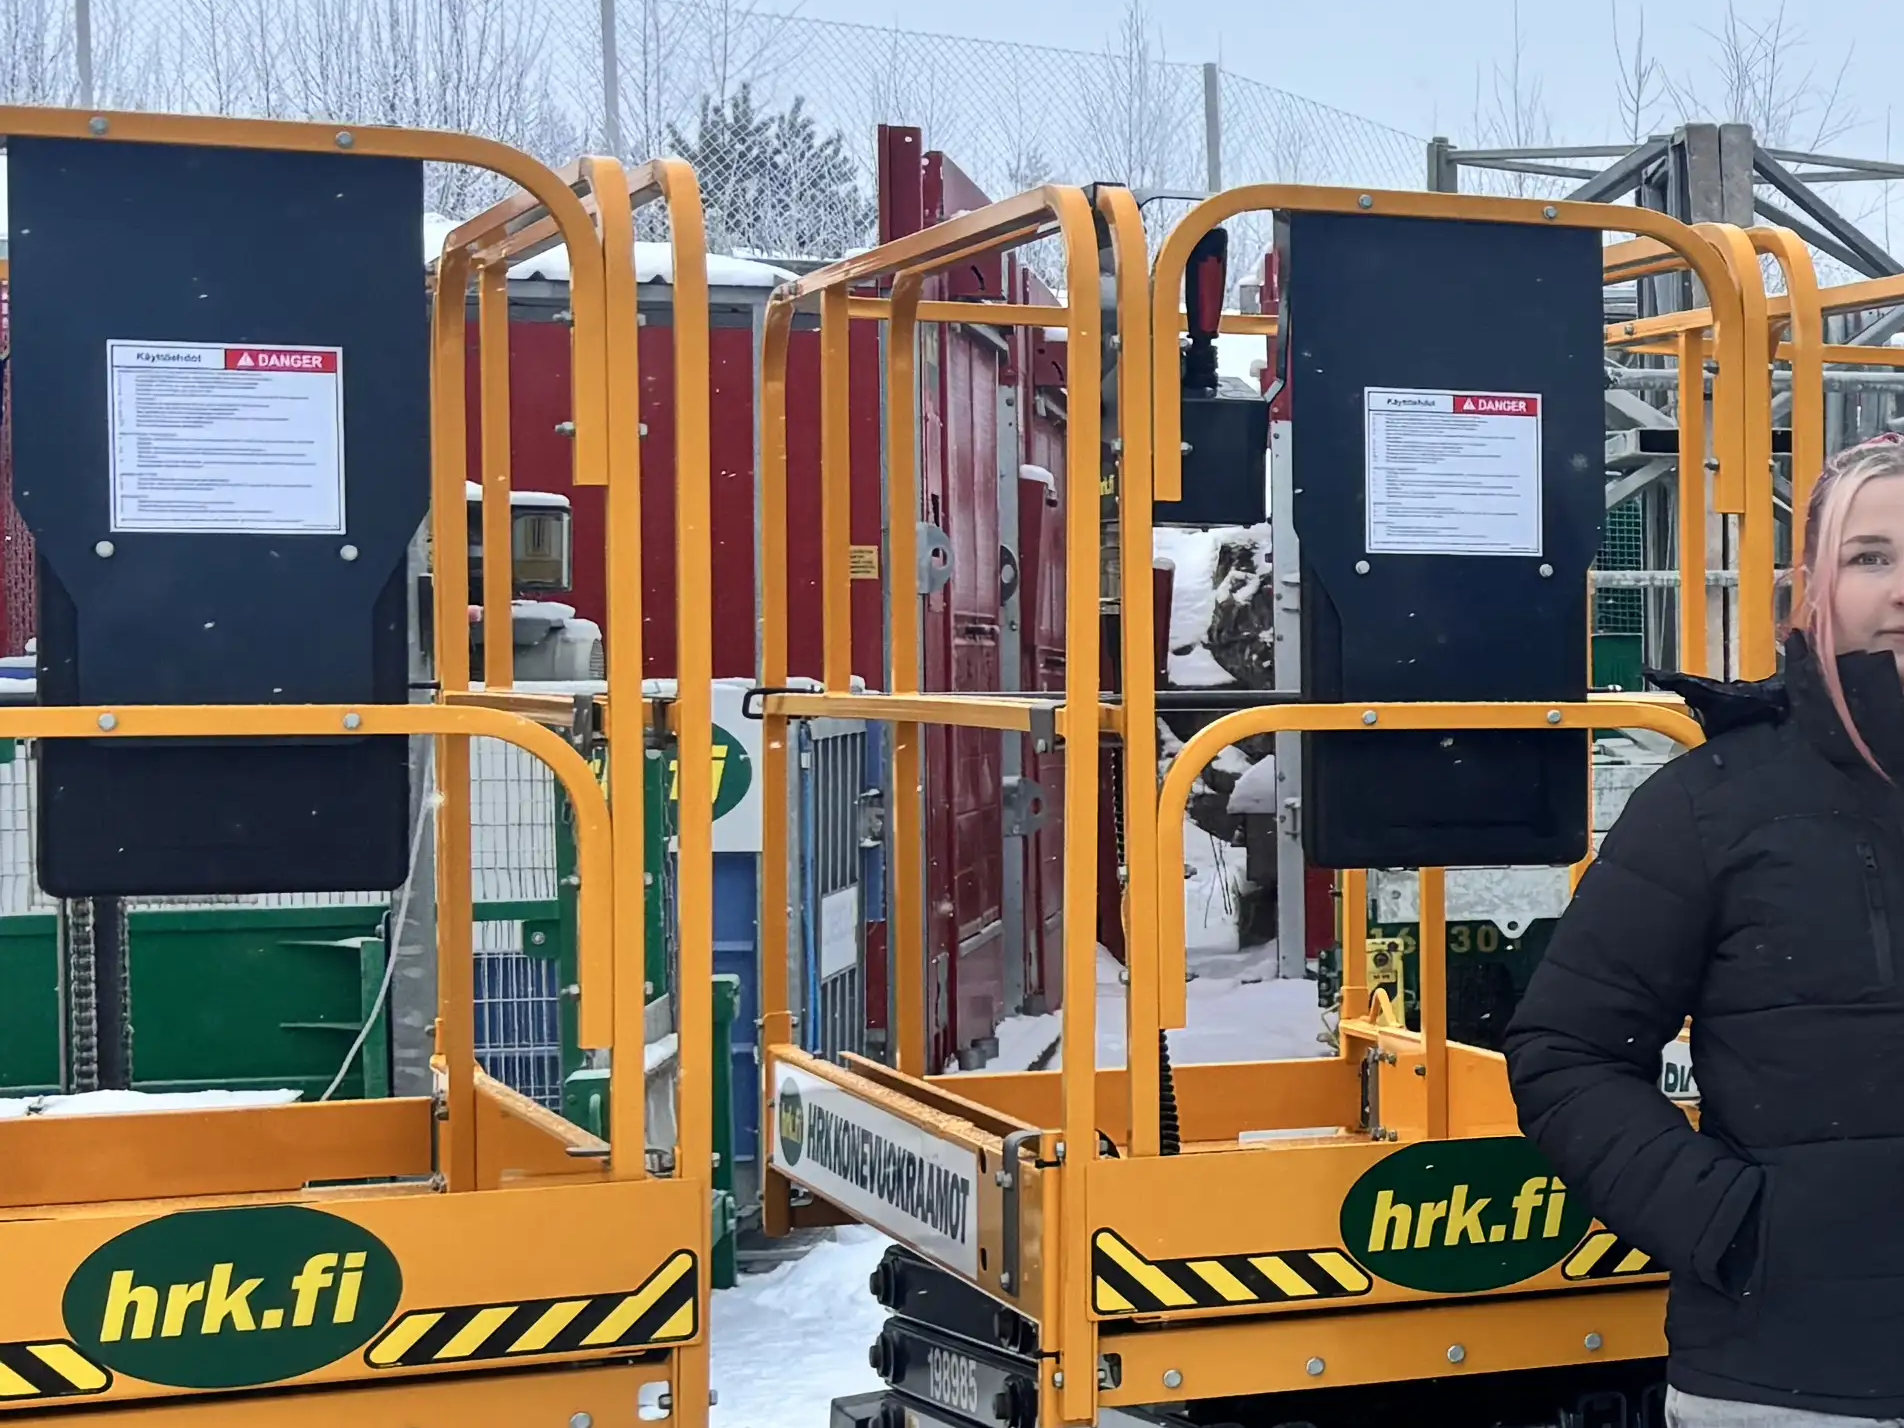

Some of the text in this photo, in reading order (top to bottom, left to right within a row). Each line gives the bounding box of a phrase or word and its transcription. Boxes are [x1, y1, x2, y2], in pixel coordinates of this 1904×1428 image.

[257, 353, 323, 368] DANGER
[1478, 399, 1527, 412] DANGER
[806, 1101, 970, 1245] HRK KONEVUOKRAAMOT
[1367, 1176, 1567, 1253] hrk.fi
[100, 1250, 368, 1343] hrk.fi
[927, 1346, 978, 1413] 198985
